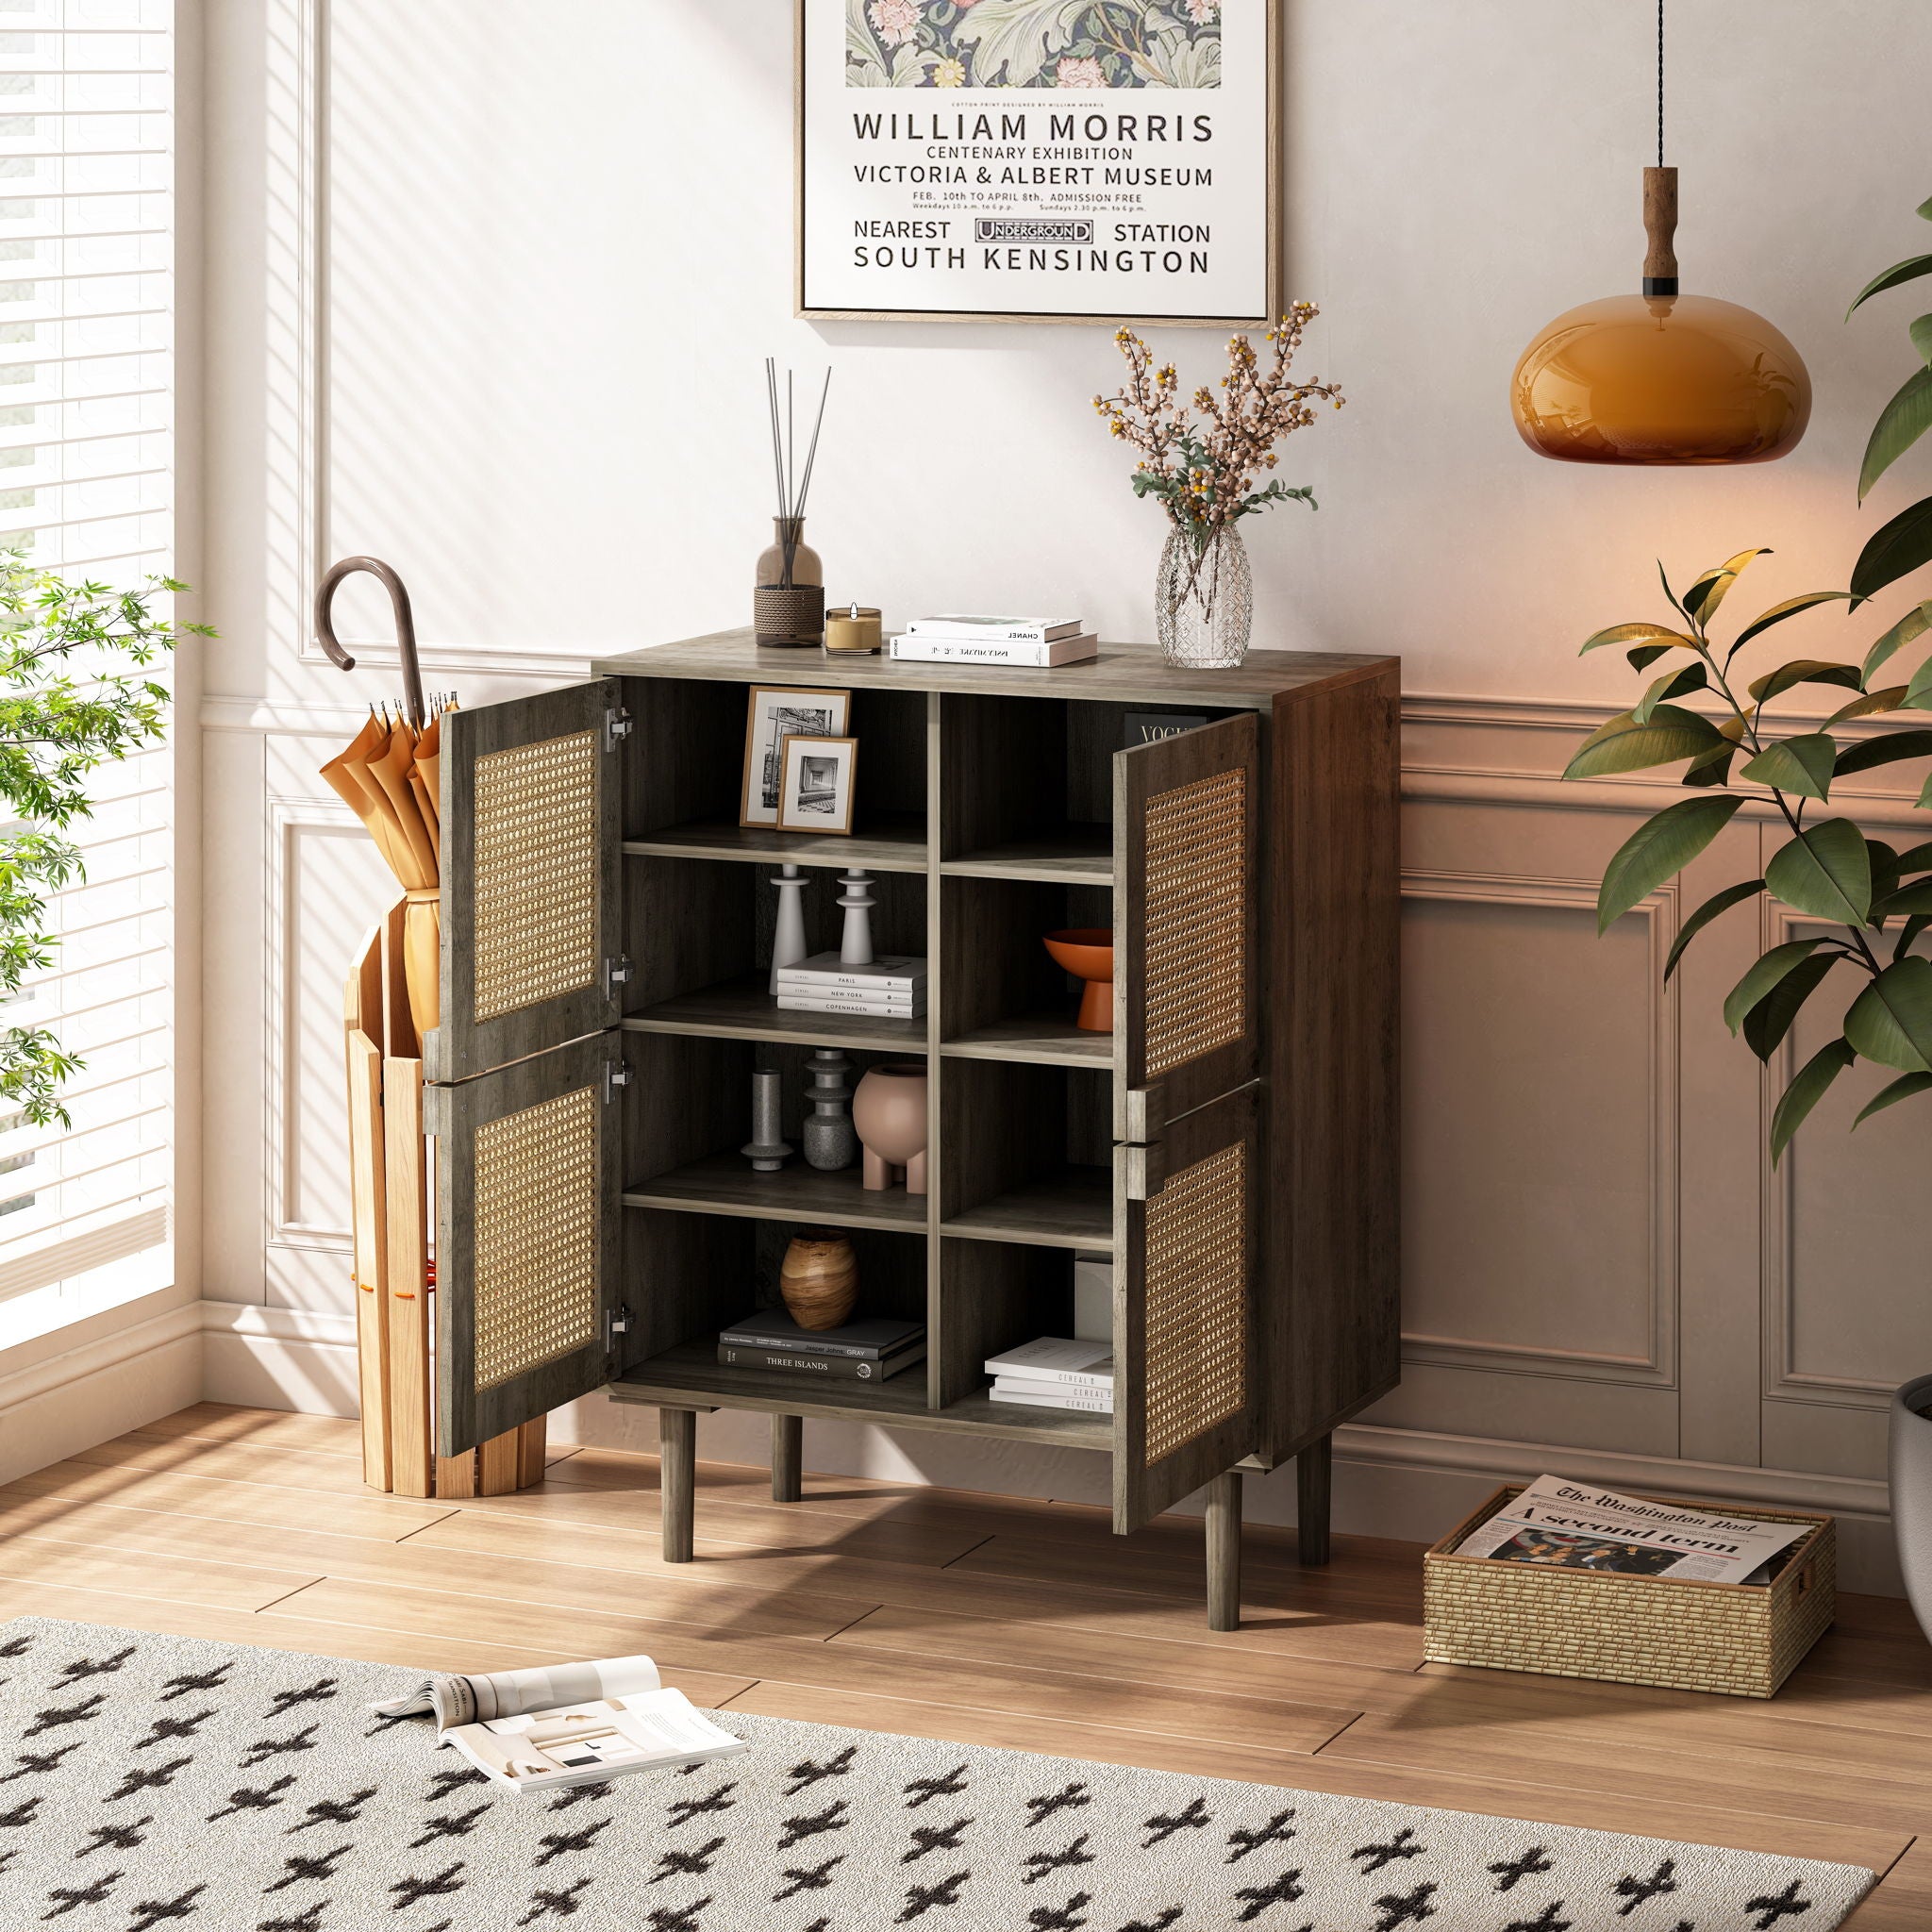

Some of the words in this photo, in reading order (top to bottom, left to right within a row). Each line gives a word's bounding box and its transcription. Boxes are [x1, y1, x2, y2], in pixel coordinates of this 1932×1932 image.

[854, 113, 1026, 141] WILLIAM
[1050, 114, 1213, 142] MORRIS
[926, 146, 1026, 159] CENTENARY
[1032, 147, 1133, 160] EXHIBITION
[854, 165, 968, 184] VICTORIA
[975, 165, 992, 184] &
[1001, 166, 1094, 186] ALBERT
[1105, 168, 1213, 187] MUSEUM
[913, 192, 937, 201] FEB.
[943, 192, 966, 201] 10th
[970, 192, 984, 201] TO
[988, 192, 1018, 202] APRIL
[1050, 192, 1111, 203] ADMISSION
[1115, 193, 1141, 203] FREE
[1040, 204, 1072, 212] Sundays
[855, 220, 951, 239] NEAREST
[977, 220, 1091, 242] UNDERGROUND
[1114, 224, 1210, 242] STATION
[854, 246, 965, 269] SOUTH
[984, 248, 1208, 274] KENSINGTON
[825, 1004, 867, 1012] COPENHAGEN
[766, 1357, 792, 1367] THREE
[794, 1359, 828, 1371] ISLANDS
[1058, 1374, 1088, 1384] CEREAL
[1074, 1388, 1104, 1398] CEREAL
[1066, 1400, 1095, 1410] CEREAL
[1557, 1487, 1591, 1502] The
[1595, 1494, 1707, 1525] Washington
[1708, 1520, 1758, 1532] Post
[1509, 1507, 1535, 1520] A
[1541, 1515, 1657, 1540] second
[1659, 1534, 1740, 1554] term
